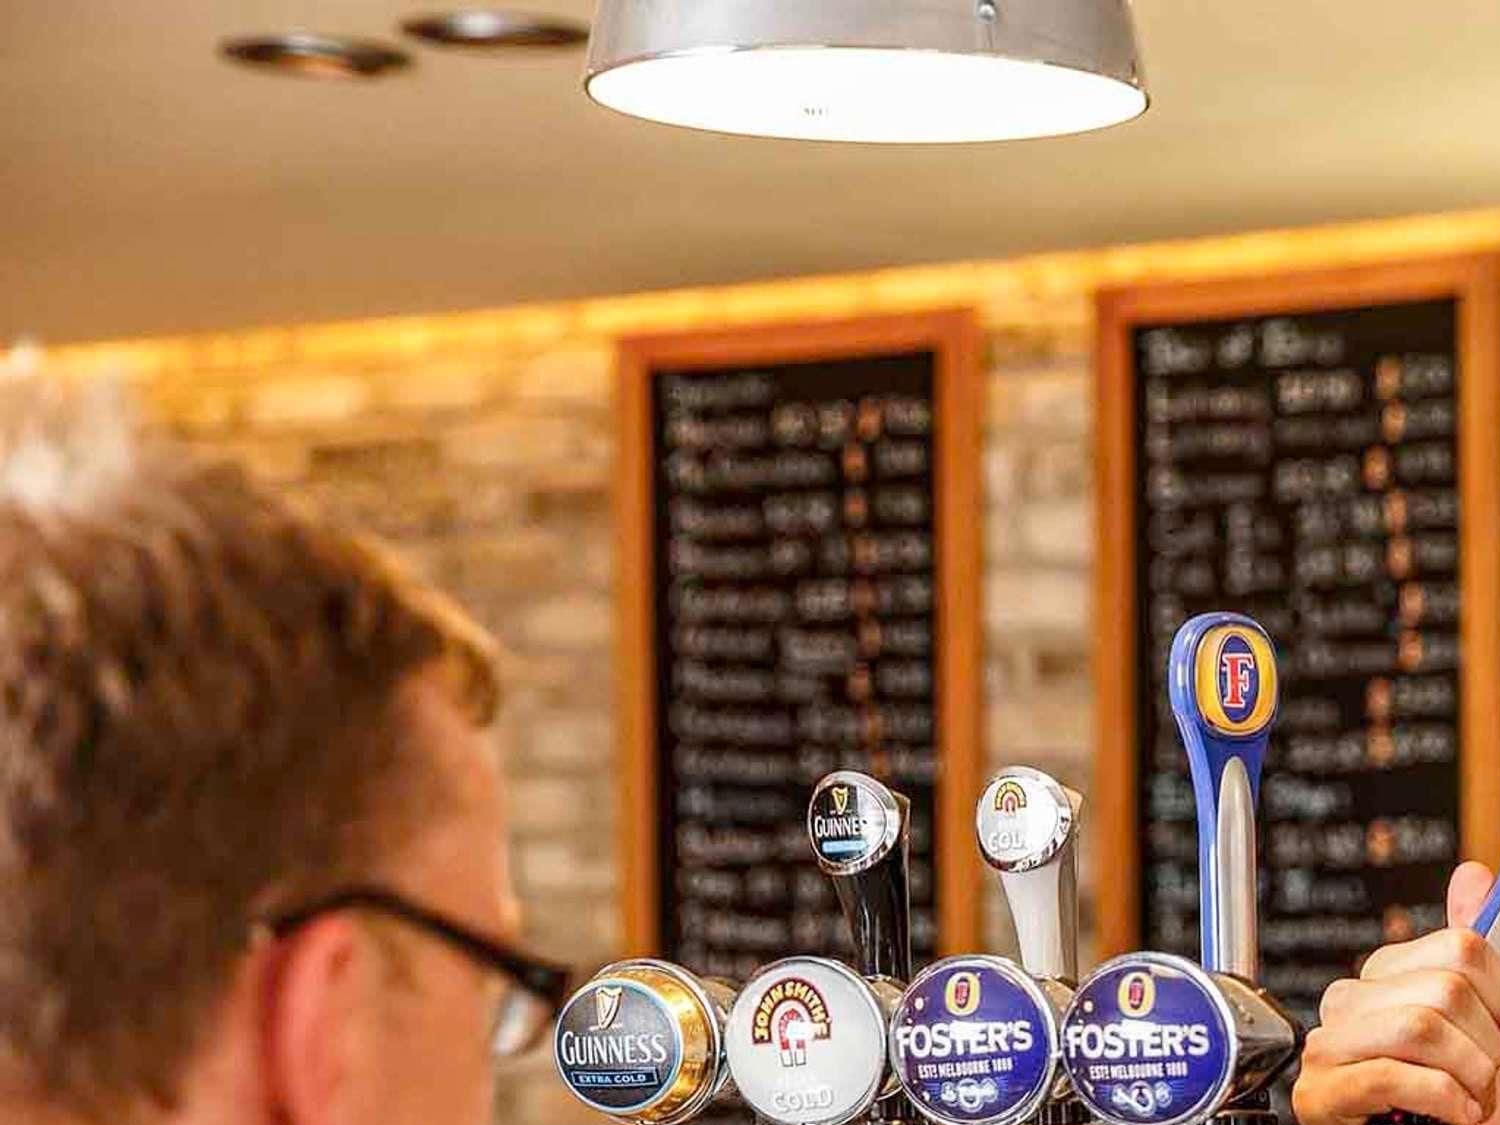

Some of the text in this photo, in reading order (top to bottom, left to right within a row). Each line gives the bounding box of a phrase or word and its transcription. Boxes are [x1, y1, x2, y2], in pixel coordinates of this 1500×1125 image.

[1222, 653, 1254, 708] F
[814, 816, 869, 837] GUINNE
[988, 831, 1029, 855] COL
[561, 1031, 667, 1065] GUINNESS
[896, 1020, 1033, 1059] FOSTER'S
[1066, 1022, 1210, 1059] FOSTER'S
[577, 1073, 647, 1084] EXTRA COLD
